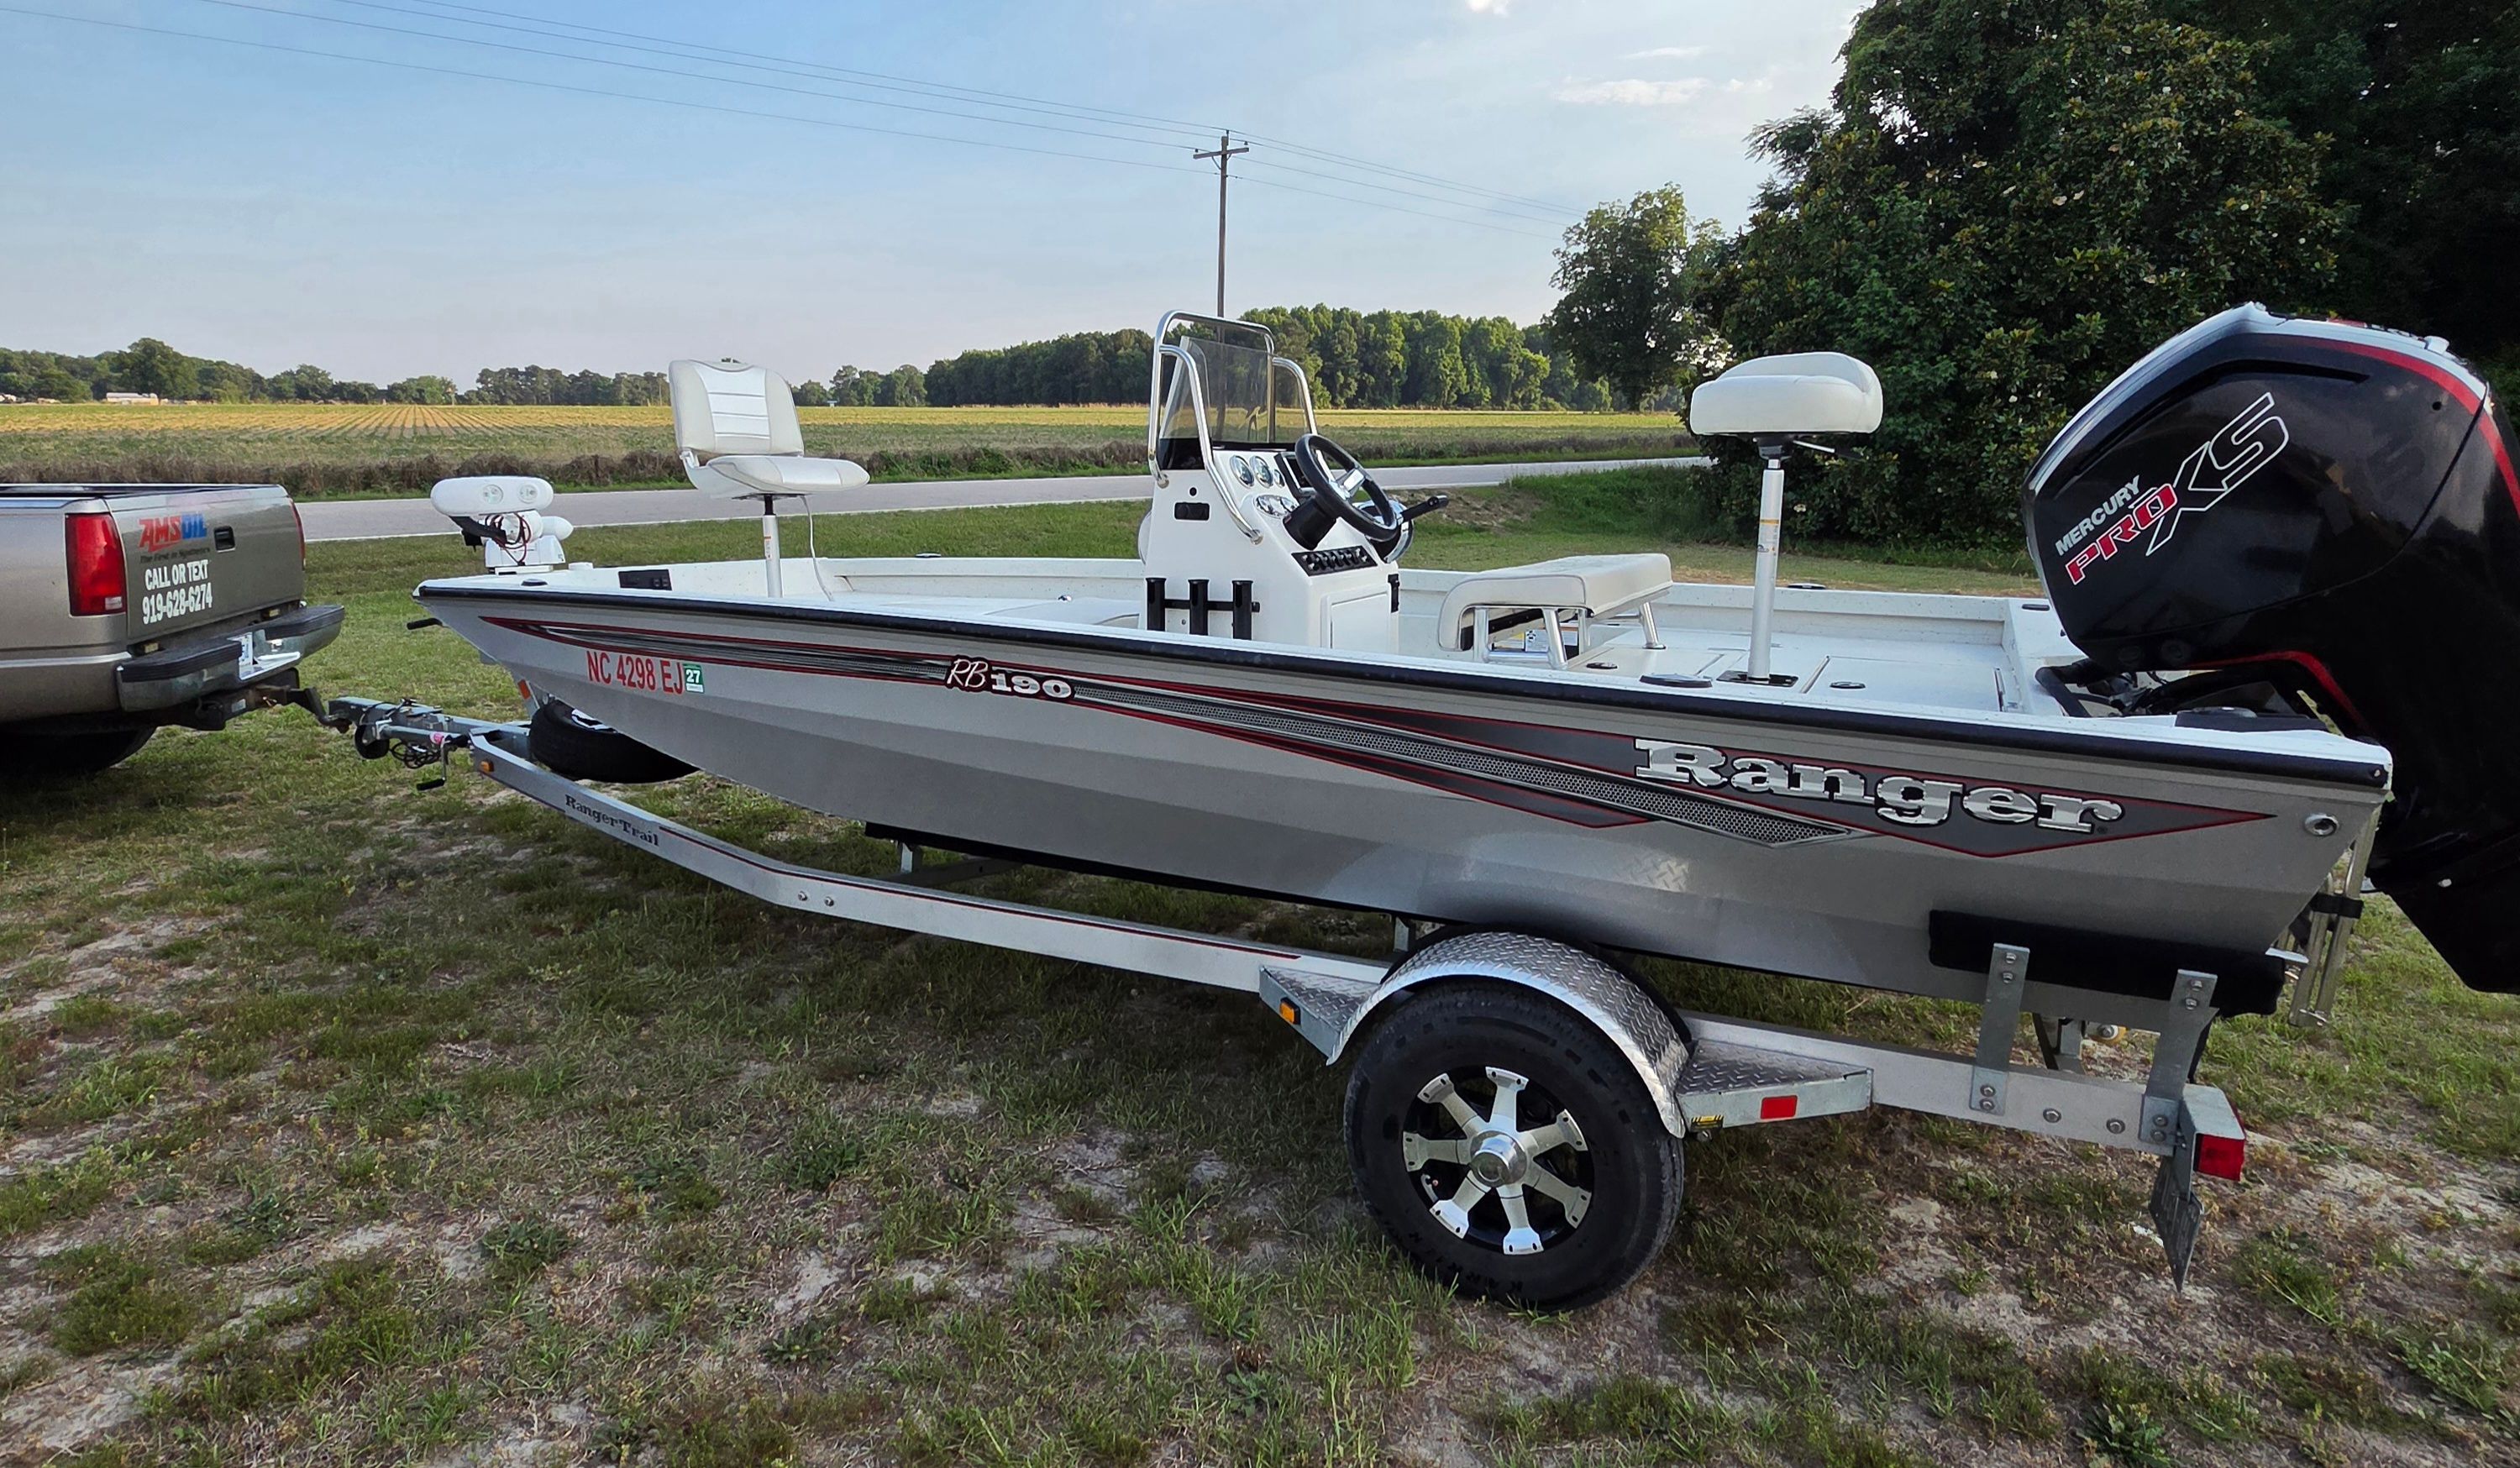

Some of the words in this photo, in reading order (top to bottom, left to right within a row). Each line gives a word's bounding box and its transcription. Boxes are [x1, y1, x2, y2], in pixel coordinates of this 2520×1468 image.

[139, 511, 207, 553] AMSOIL
[2055, 474, 2140, 557] MERCURY
[144, 566, 171, 590] CALL
[171, 564, 186, 585] OR
[186, 559, 208, 582] TEXT
[142, 582, 213, 625] 919-628-6274
[586, 650, 612, 684] NC
[616, 655, 656, 690] 4298
[659, 659, 683, 695] EJ
[685, 668, 701, 684] 27
[947, 658, 989, 688] RB
[990, 673, 1072, 699] 190
[1634, 738, 2123, 834] Ranger
